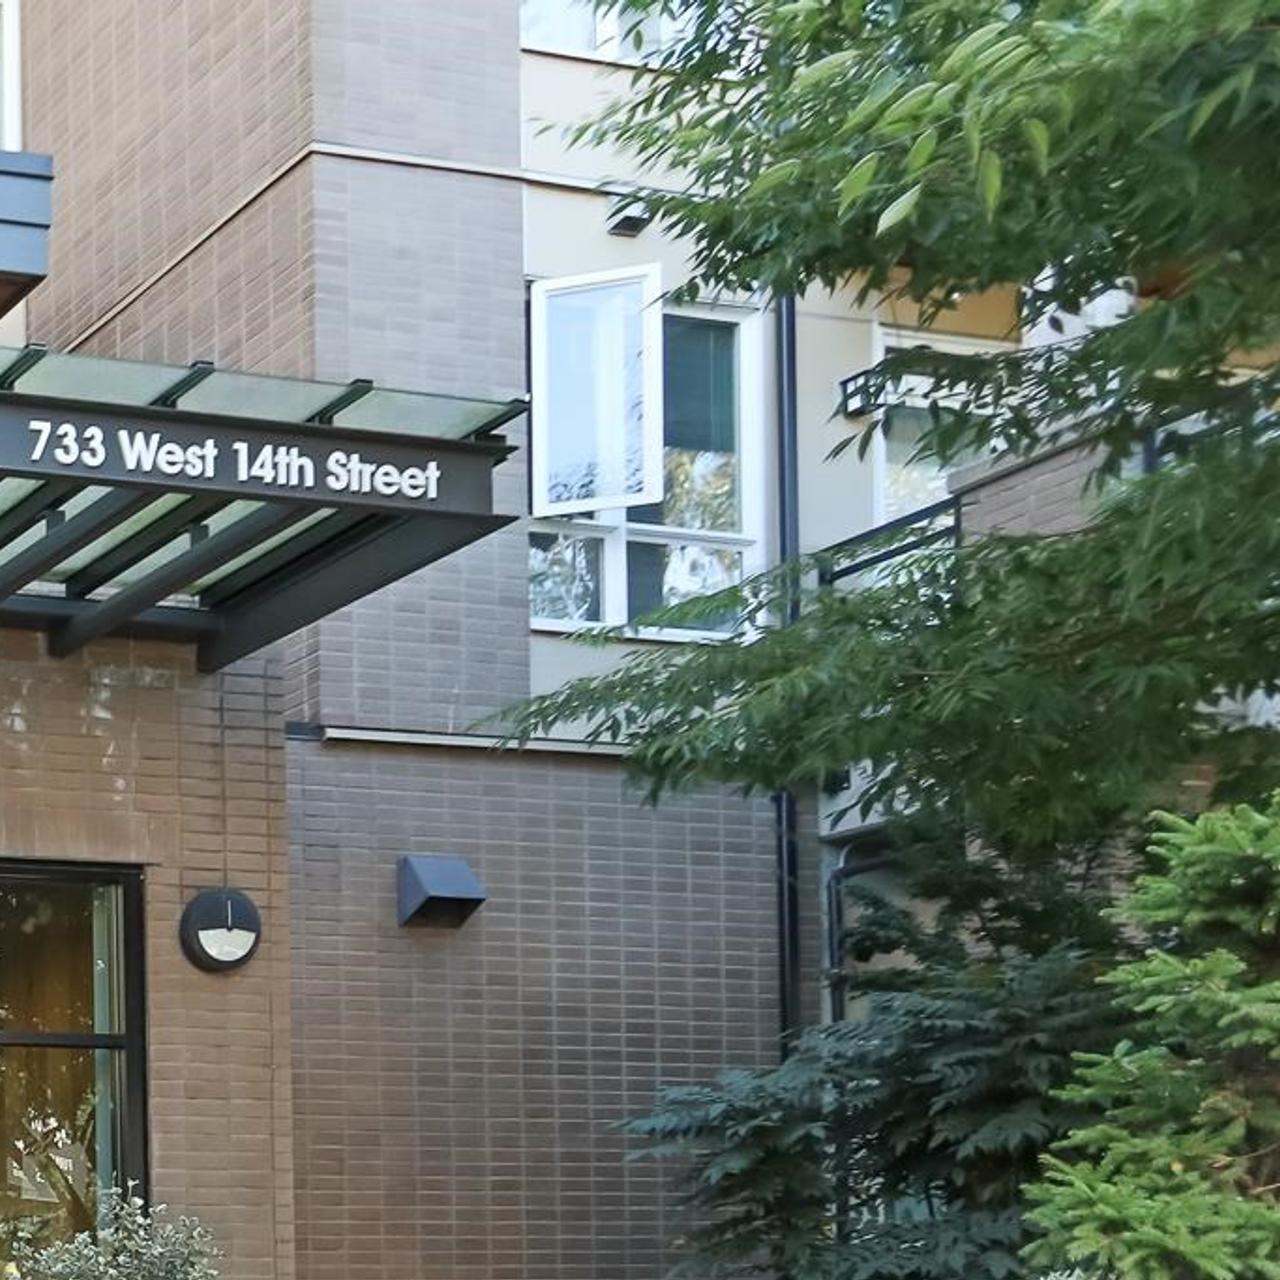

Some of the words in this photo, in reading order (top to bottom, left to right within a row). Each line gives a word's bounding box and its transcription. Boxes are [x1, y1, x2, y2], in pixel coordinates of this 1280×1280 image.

[27, 420, 107, 468] 733
[117, 428, 218, 478] West
[231, 441, 315, 487] 14th
[324, 455, 441, 499] Street
